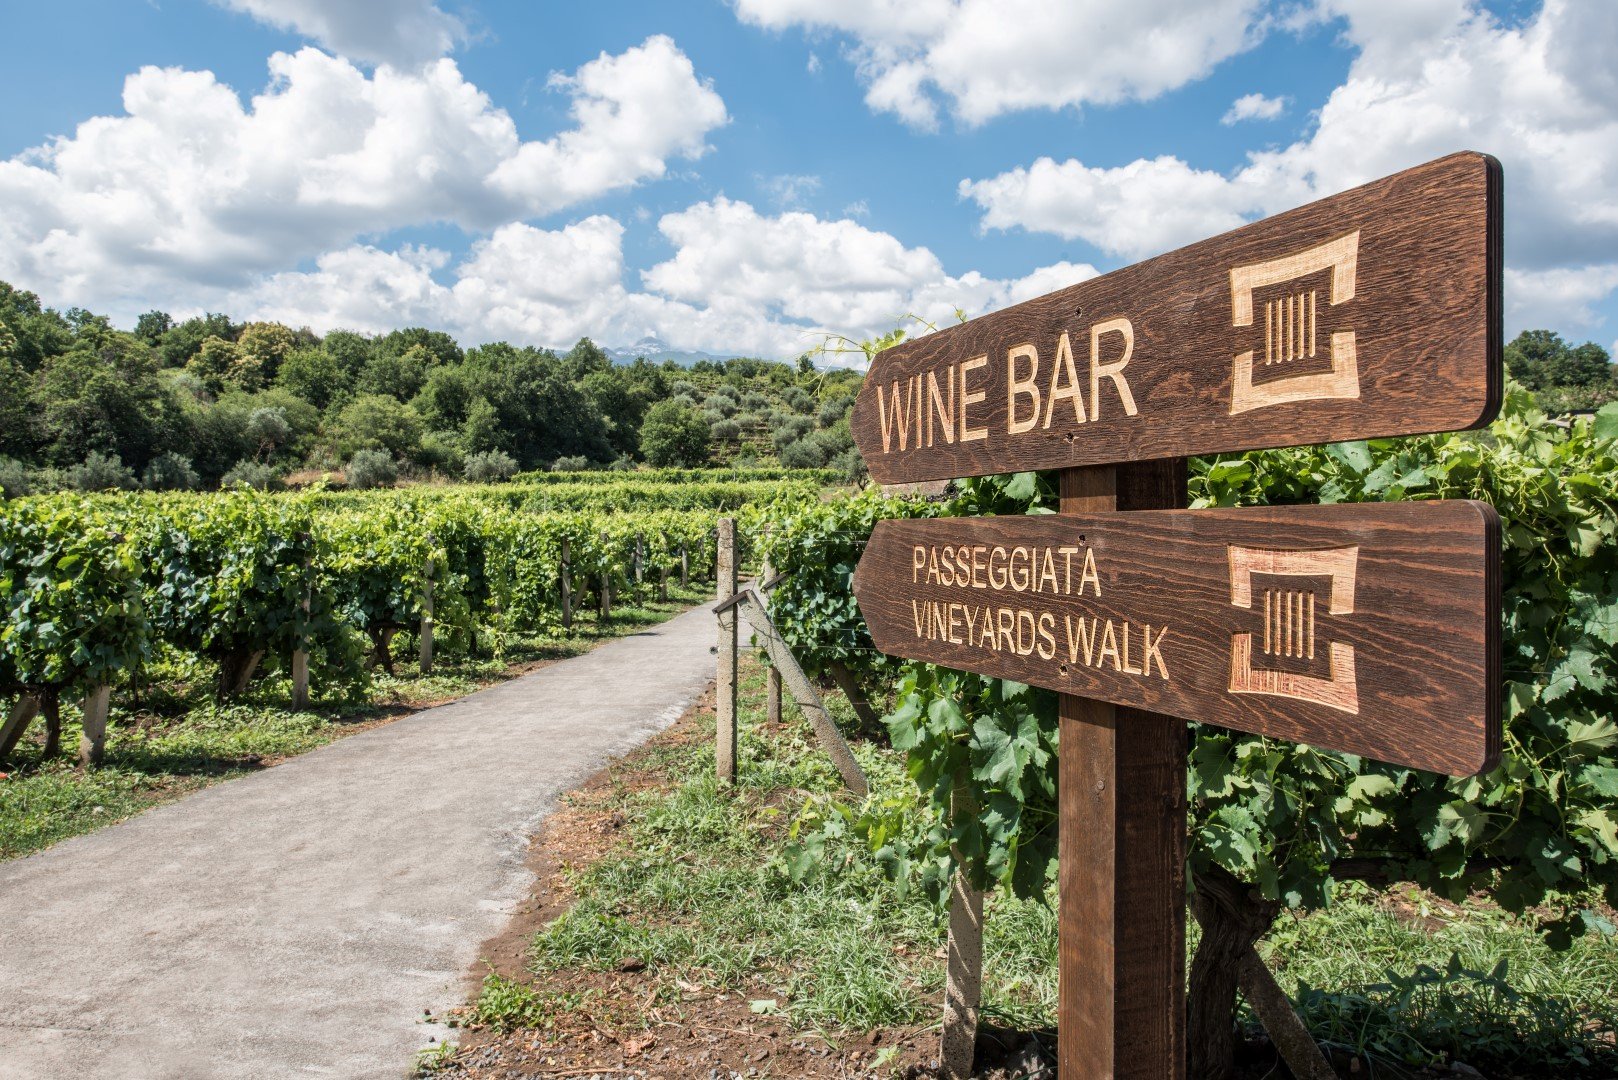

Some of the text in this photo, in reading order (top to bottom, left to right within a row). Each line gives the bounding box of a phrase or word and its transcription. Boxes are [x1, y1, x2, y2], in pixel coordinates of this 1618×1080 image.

[877, 317, 1138, 453] WINE BAR
[913, 545, 1102, 597] PASSEGGIATA
[912, 599, 1169, 680] VINEYARDS WALK
